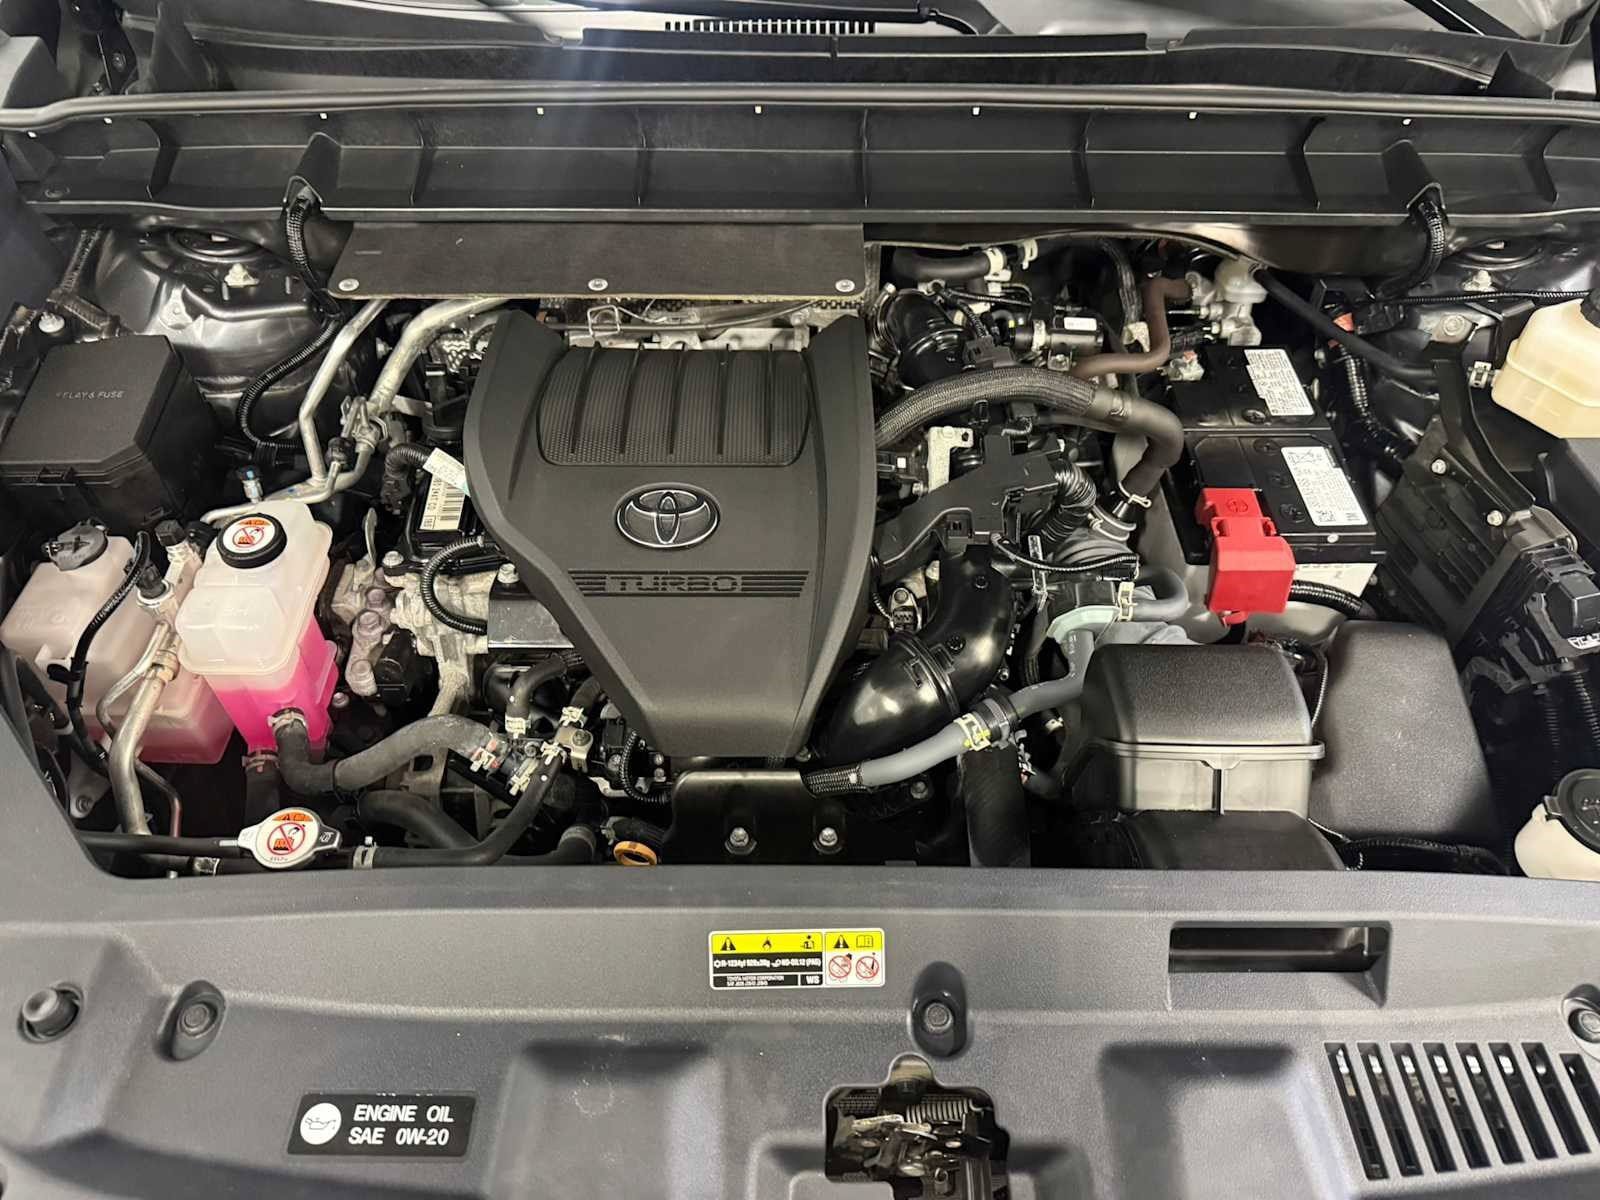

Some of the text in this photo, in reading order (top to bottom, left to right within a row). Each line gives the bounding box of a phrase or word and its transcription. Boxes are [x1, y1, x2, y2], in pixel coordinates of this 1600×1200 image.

[97, 390, 125, 399] FUSE
[609, 575, 738, 592] TURBO
[805, 975, 820, 985] WS
[353, 1104, 455, 1123] ENGINE OIL
[348, 1127, 450, 1146] SAE 0W-20
